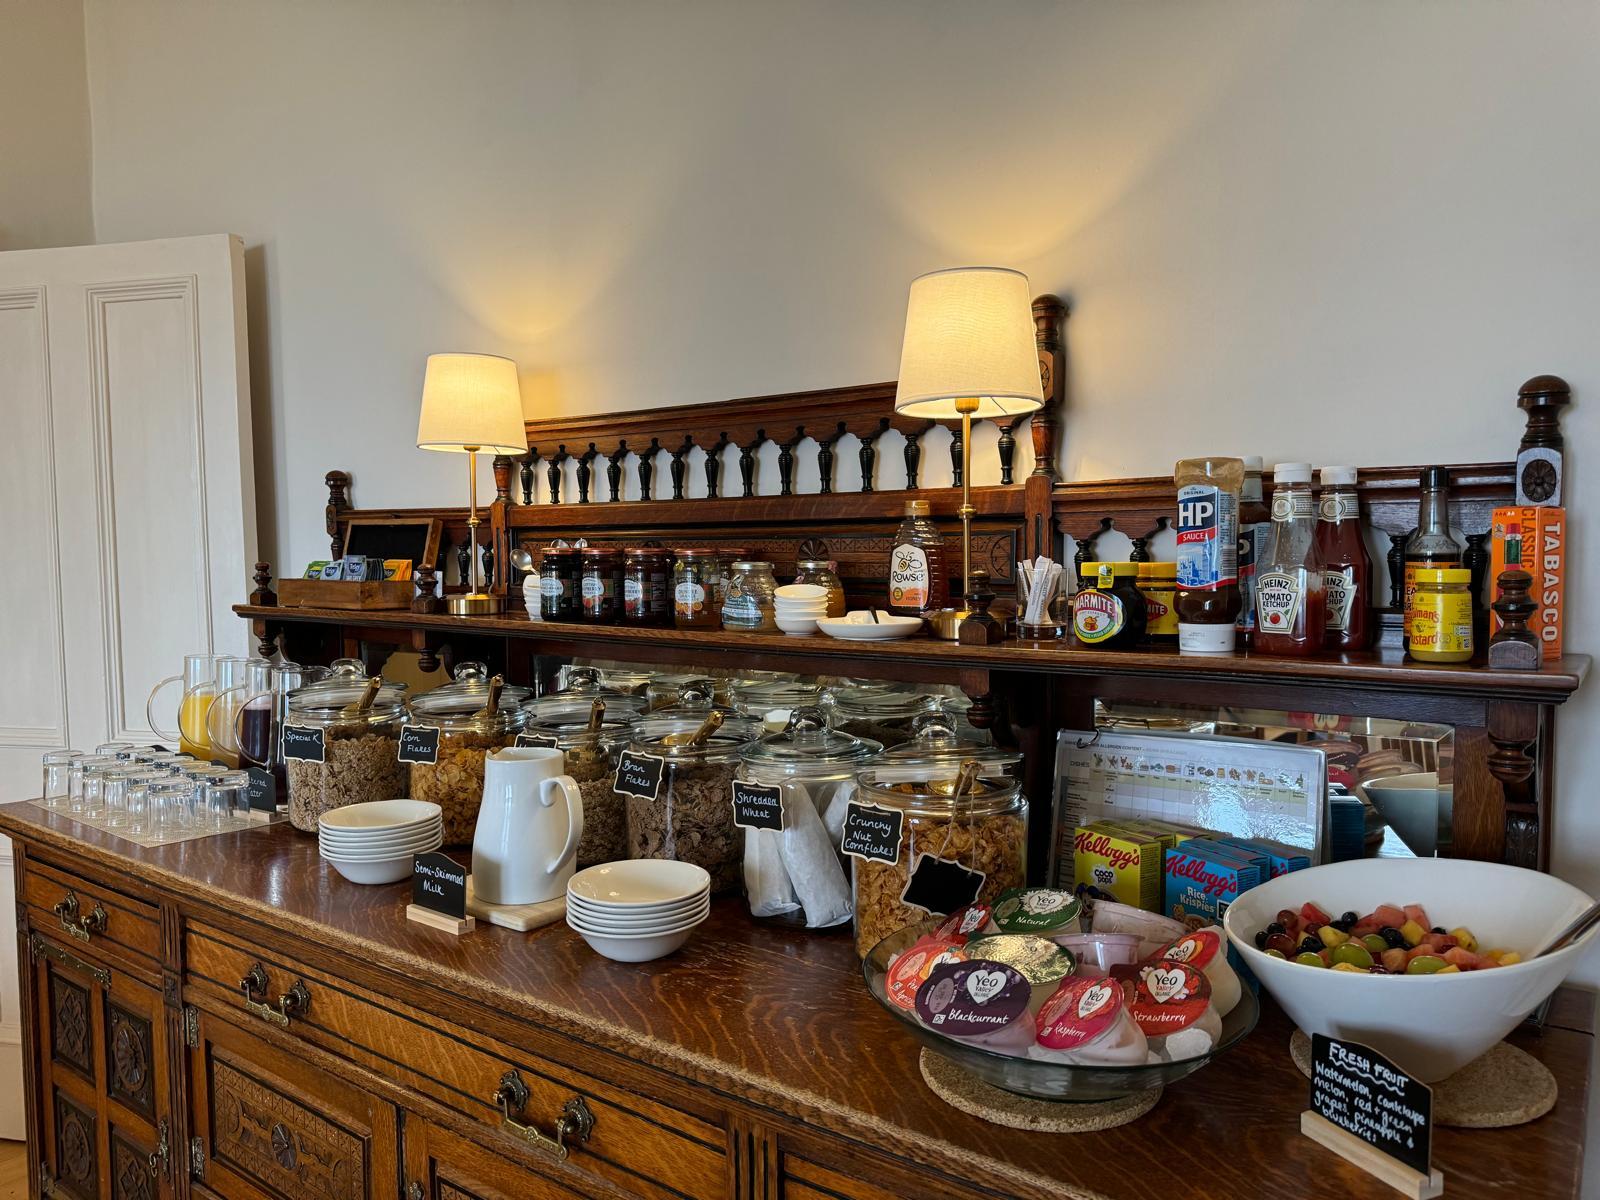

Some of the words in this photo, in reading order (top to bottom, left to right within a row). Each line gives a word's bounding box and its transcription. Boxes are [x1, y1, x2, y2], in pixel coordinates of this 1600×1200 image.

[1178, 501, 1214, 527] HP
[1183, 532, 1205, 542] SAUCE
[1521, 508, 1537, 569] CLASSIC
[1264, 579, 1289, 589] HEINZ
[1326, 577, 1343, 587] INZ
[1541, 522, 1561, 642] TABASCO
[1261, 592, 1292, 602] TOMATO
[1327, 590, 1346, 600] ATO
[1074, 593, 1114, 613] MARMITE
[1263, 601, 1290, 609] KETCHUP
[312, 733, 321, 744] K
[407, 744, 431, 753] Flakes
[621, 760, 645, 773] Bran
[624, 773, 650, 787] Flakes
[742, 807, 771, 819] Wheat
[849, 813, 892, 838] Crunchy
[853, 831, 872, 842] Nut
[845, 839, 894, 857] Cornflakes
[1074, 832, 1140, 870] Kellogg's
[1166, 854, 1237, 897] Kellogg's
[423, 879, 445, 896] Milk
[1036, 895, 1056, 905] Yeo
[1180, 893, 1216, 913] Krispies
[1015, 916, 1051, 927] Natural
[1168, 945, 1189, 959] Yeo
[975, 974, 999, 988] Yeo
[1154, 973, 1178, 986] Yeo
[1086, 990, 1104, 1002] Yeo
[948, 1008, 1010, 1025] Blackcurrant
[1133, 1010, 1186, 1025] Strawberry
[1055, 1022, 1087, 1039] Raspberry
[1329, 1042, 1371, 1073] FRESH
[1374, 1063, 1409, 1088] FRUIT
[1354, 1097, 1372, 1113] red
[1382, 1111, 1413, 1134] green
[1322, 1106, 1377, 1142] blueberries
[1354, 1112, 1402, 1143] pineapple
